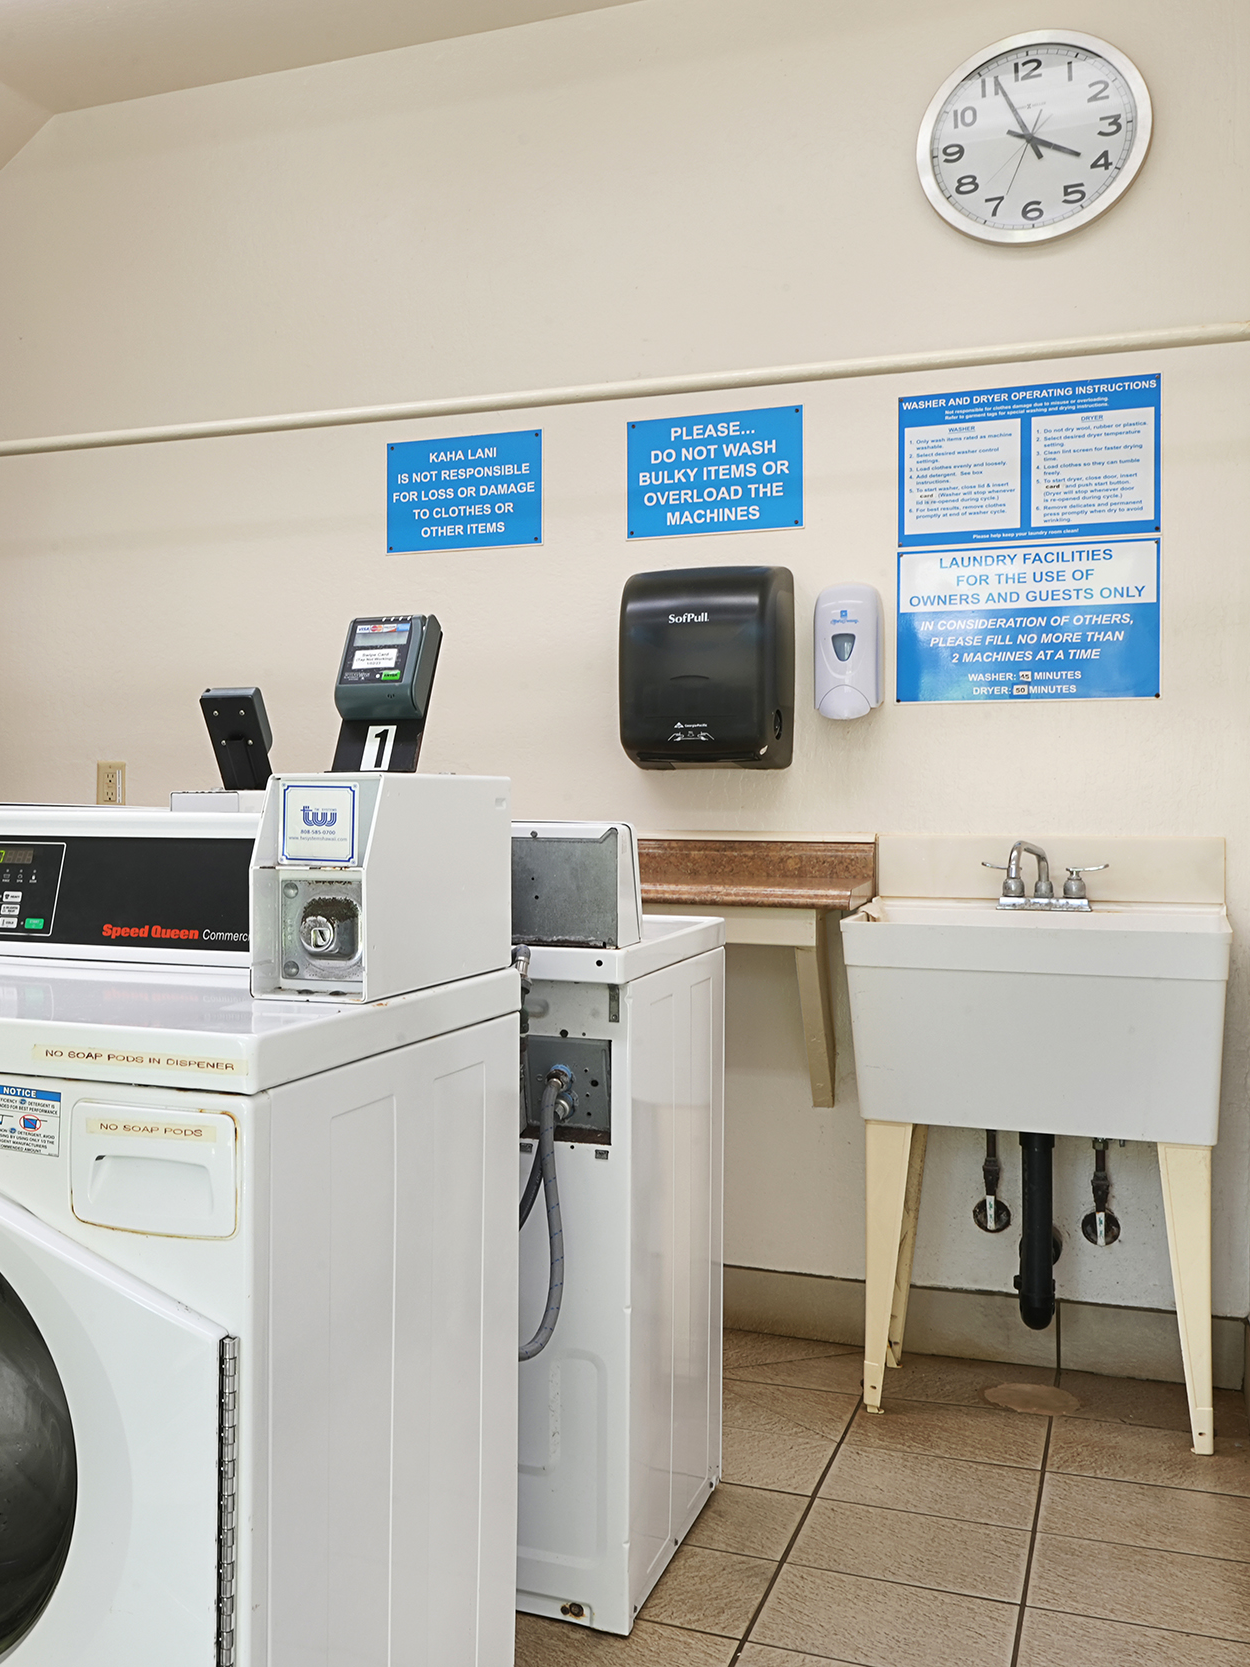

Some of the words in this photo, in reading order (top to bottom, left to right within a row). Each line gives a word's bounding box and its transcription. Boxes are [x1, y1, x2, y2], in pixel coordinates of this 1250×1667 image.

[1013, 58, 1043, 82] 12
[1067, 61, 1073, 82] 1
[980, 75, 1000, 99] 11
[1086, 80, 1110, 103] 2
[952, 105, 978, 129] 10
[1097, 113, 1122, 137] 3
[942, 143, 965, 164] 9
[1089, 150, 1113, 171] 4
[954, 174, 980, 196] 8
[1061, 182, 1087, 204] 5
[984, 195, 1005, 217] 7
[1020, 200, 1044, 221] 6
[902, 398, 946, 411] WASHER
[948, 396, 971, 407] AND
[973, 393, 1009, 404] DRYER
[1011, 387, 1073, 401] OPERATING
[1075, 379, 1157, 395] INSTRUCTIONS
[955, 406, 984, 414] responsible
[1012, 402, 1032, 410] damage
[1077, 396, 1109, 405] overloading.
[1007, 408, 1025, 416] special
[1059, 404, 1076, 412] drying
[671, 421, 755, 441] PLEASE...
[429, 450, 465, 463] KAHA
[468, 447, 497, 460] LANI
[650, 449, 676, 464] DO
[681, 445, 718, 462] NOT
[722, 439, 777, 457] WASH
[397, 473, 409, 484] IS
[412, 471, 438, 483] NOT
[441, 463, 530, 481] RESPONSIBLE
[638, 467, 698, 486] BULKY
[703, 462, 757, 480] ITEMS
[762, 460, 790, 475] OR
[392, 491, 418, 503] FOR
[421, 488, 454, 501] LOSS
[457, 486, 476, 498] OR
[479, 481, 535, 496] DAMAGE
[643, 485, 742, 506] OVERLOAD
[747, 482, 784, 498] THE
[412, 509, 430, 520] TO
[432, 504, 491, 519] CLOTHES
[495, 502, 514, 514] OR
[666, 505, 760, 526] MACHINES
[421, 524, 464, 538] OTHER
[467, 521, 505, 534] ITEMS
[1028, 529, 1048, 537] laundry
[939, 553, 1018, 569] LAUNDRY
[1023, 549, 1113, 564] FACILITIES
[956, 574, 990, 587] FOR
[994, 572, 1027, 585] THE
[1032, 570, 1066, 583] USE
[1072, 568, 1095, 581] OF
[909, 593, 981, 607] OWNERS
[985, 591, 1020, 604] AND
[1025, 587, 1094, 602] GUESTS
[1099, 585, 1146, 599] ONLY
[668, 612, 709, 624] SofPull
[920, 621, 934, 631] IN
[937, 616, 1047, 631] CONSIDERATION
[1050, 615, 1070, 627] OF
[1073, 613, 1134, 625] OTHERS,
[930, 635, 982, 647] PLEASE
[985, 634, 1013, 646] FILL
[1017, 633, 1037, 645] NO
[1041, 632, 1082, 644] MORE
[1086, 631, 1125, 642] THAN
[952, 653, 960, 663] 2
[962, 650, 1033, 663] MACHINES
[1036, 650, 1053, 661] AT
[1054, 650, 1065, 660] A
[1068, 648, 1101, 660] TIME
[968, 673, 1017, 682] WASHER:
[1034, 671, 1082, 681] MINUTES
[973, 686, 1011, 695] DRYER:
[1015, 686, 1027, 694] 50
[1029, 685, 1077, 694] MINUTES
[374, 728, 389, 769] 1
[300, 806, 337, 827] tw
[102, 924, 149, 939] Speed
[151, 925, 199, 939] Queen
[202, 929, 249, 941] Commerc
[45, 1049, 64, 1058] NO
[67, 1050, 103, 1060] SOAP
[107, 1053, 144, 1064] PODS
[149, 1057, 161, 1065] IN
[166, 1058, 235, 1071] DISPENER
[3, 1086, 37, 1098] NOTICE
[100, 1122, 119, 1131] NO
[122, 1124, 160, 1134] SOAP
[163, 1127, 203, 1137] PODS
